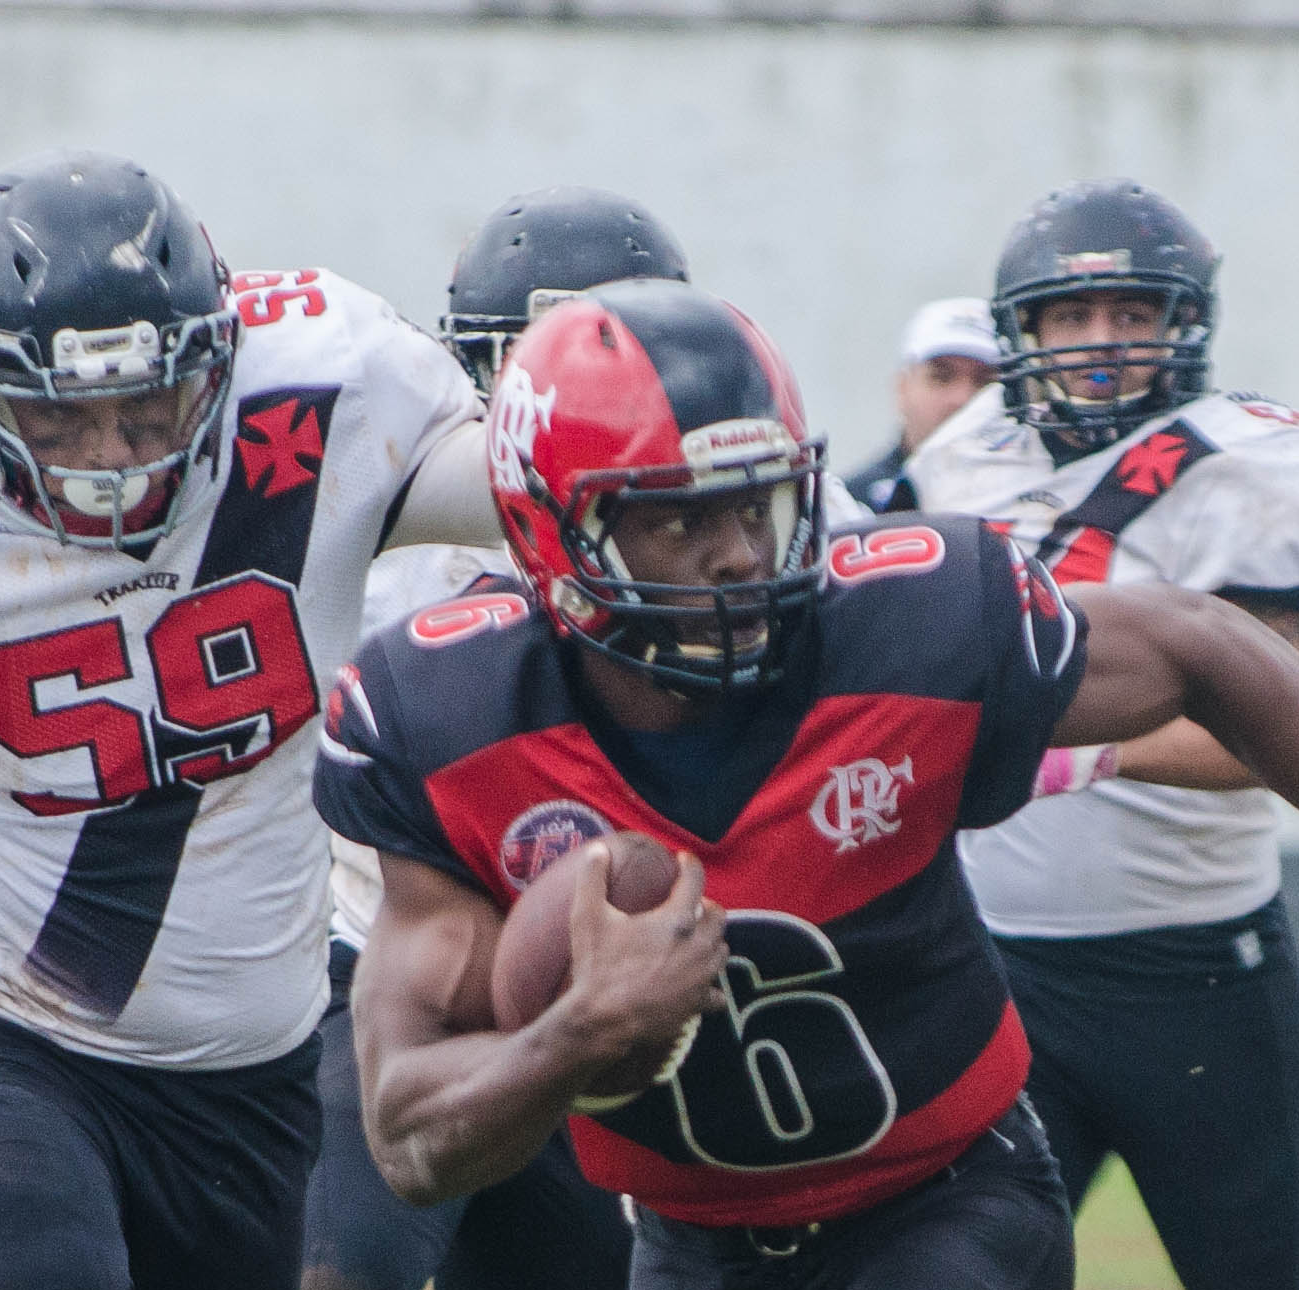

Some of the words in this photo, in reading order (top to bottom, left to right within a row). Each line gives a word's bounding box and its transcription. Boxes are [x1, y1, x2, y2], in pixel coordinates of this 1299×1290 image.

[709, 424, 768, 449] Riddell
[828, 526, 946, 587] 6
[408, 592, 530, 648] 6
[675, 907, 899, 1173] 6
